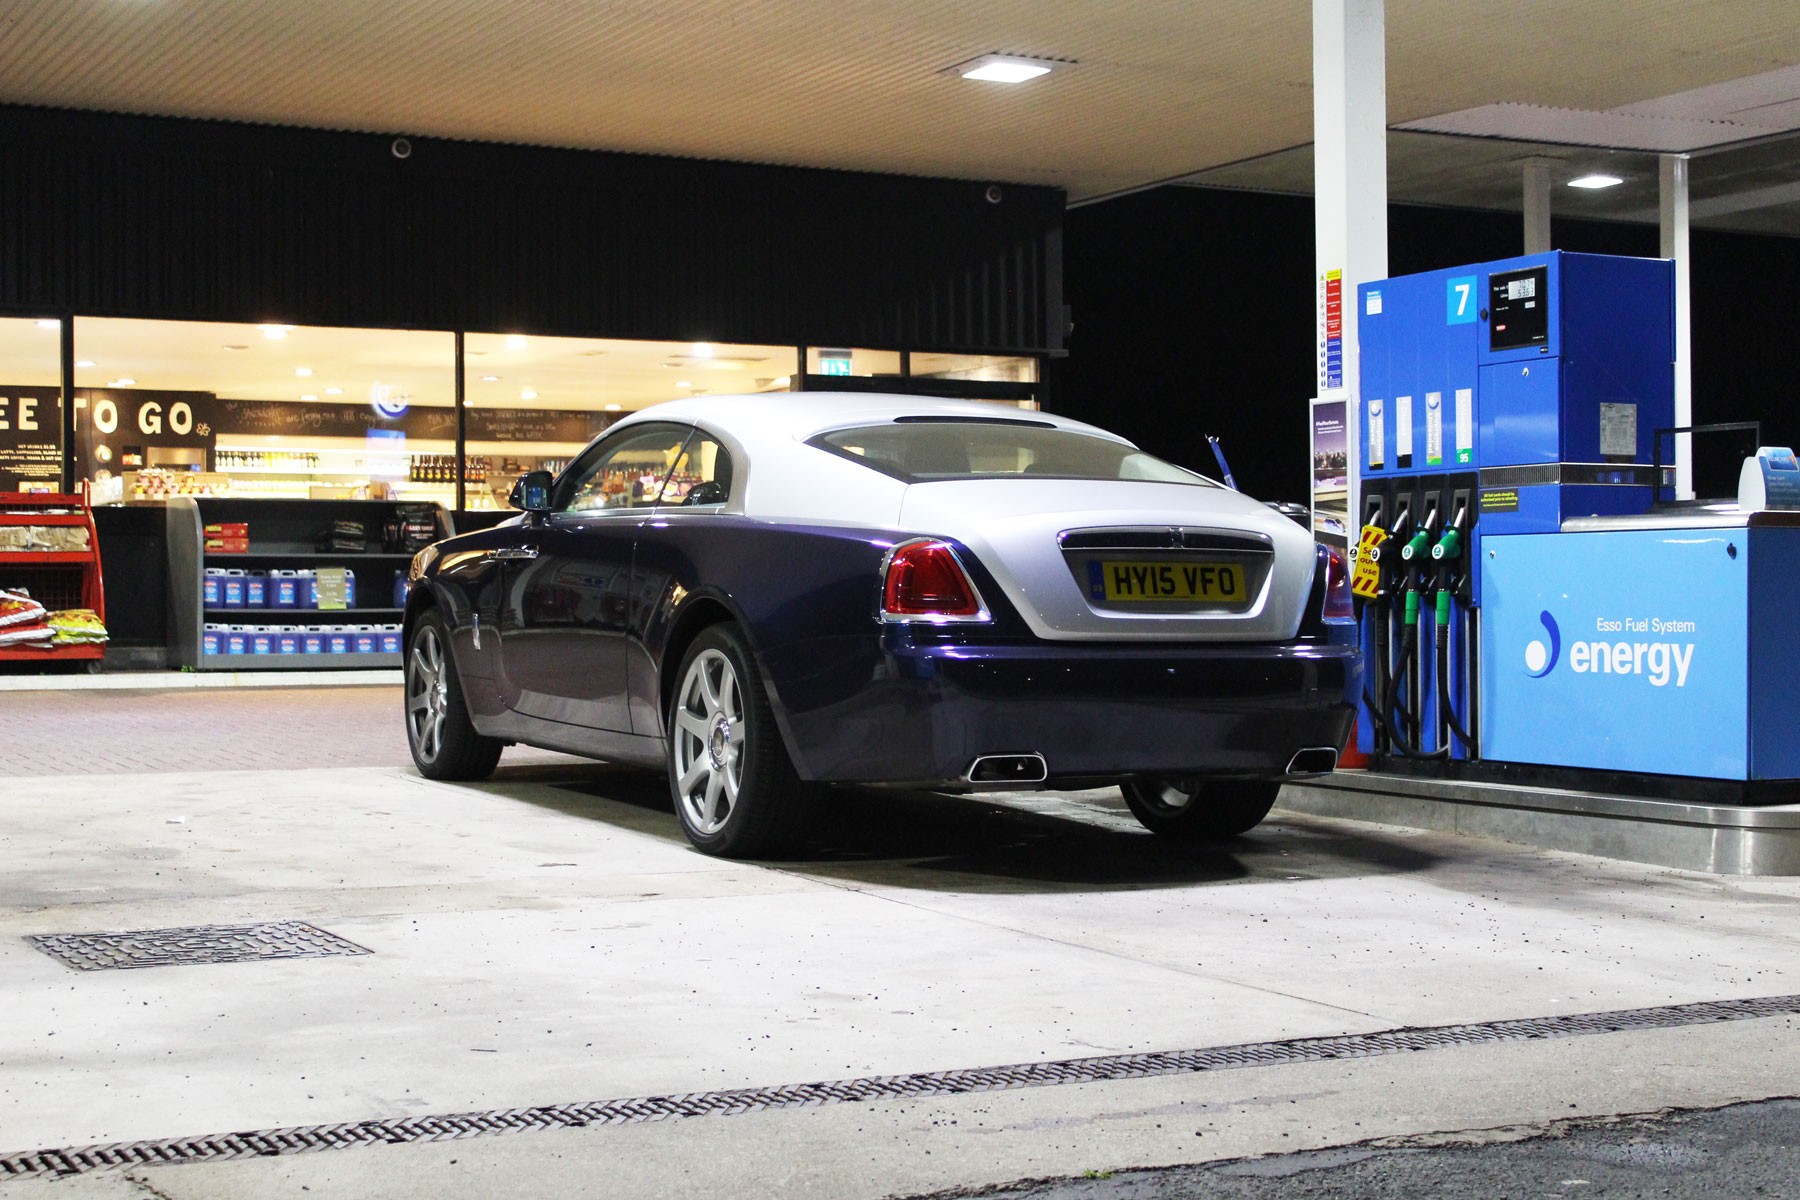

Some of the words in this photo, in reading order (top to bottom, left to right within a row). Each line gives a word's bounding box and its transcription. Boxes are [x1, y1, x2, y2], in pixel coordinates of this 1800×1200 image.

[1455, 284, 1470, 316] 7
[57, 397, 118, 433] TO
[138, 401, 192, 435] GO
[1460, 453, 1469, 463] 95
[1114, 566, 1176, 594] HY15
[1363, 567, 1377, 576] use
[1596, 617, 1622, 632] Esso
[1625, 617, 1648, 632] Fuel
[1651, 617, 1695, 635] System
[1570, 640, 1695, 687] energy
